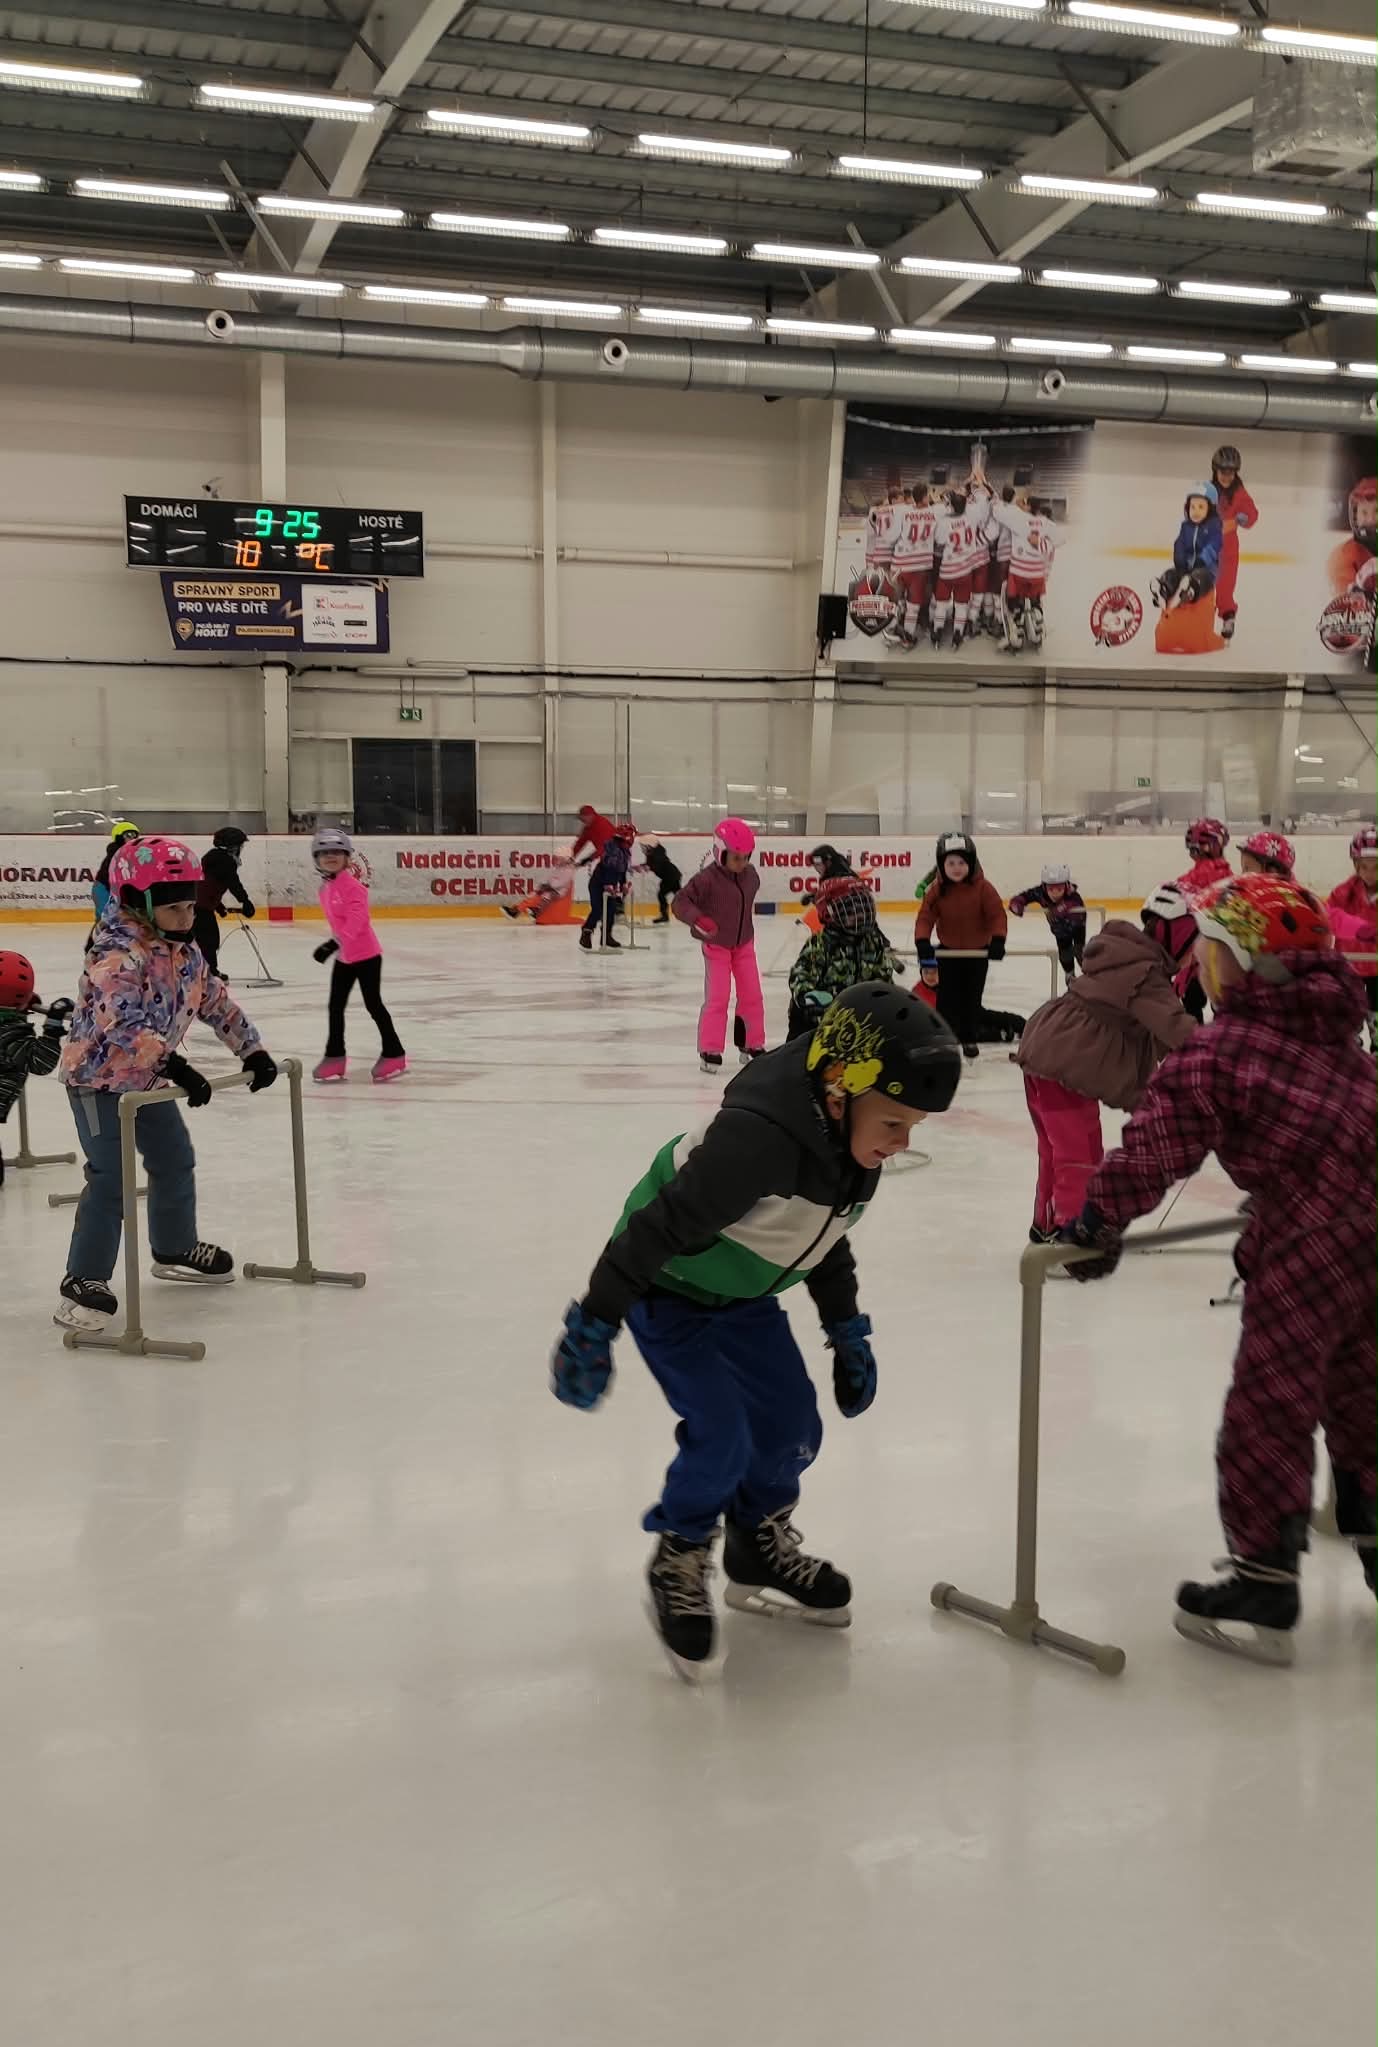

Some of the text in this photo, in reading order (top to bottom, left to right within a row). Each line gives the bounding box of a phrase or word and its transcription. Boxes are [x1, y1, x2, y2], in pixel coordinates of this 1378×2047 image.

[141, 503, 198, 519] DOMÁCÍ
[255, 509, 320, 538] 9 25
[358, 514, 404, 530] HOSTÉ
[233, 541, 261, 567] 10
[177, 583, 277, 597] SPRÁVNÝ SPORT
[178, 600, 269, 614] PRO VAŠE DÍTĚ
[194, 628, 229, 638] HOKEJ
[396, 849, 500, 869] Nadační
[860, 850, 911, 868] fond
[0, 867, 95, 882] ORAVIA
[430, 874, 534, 896] OCELÁŘI
